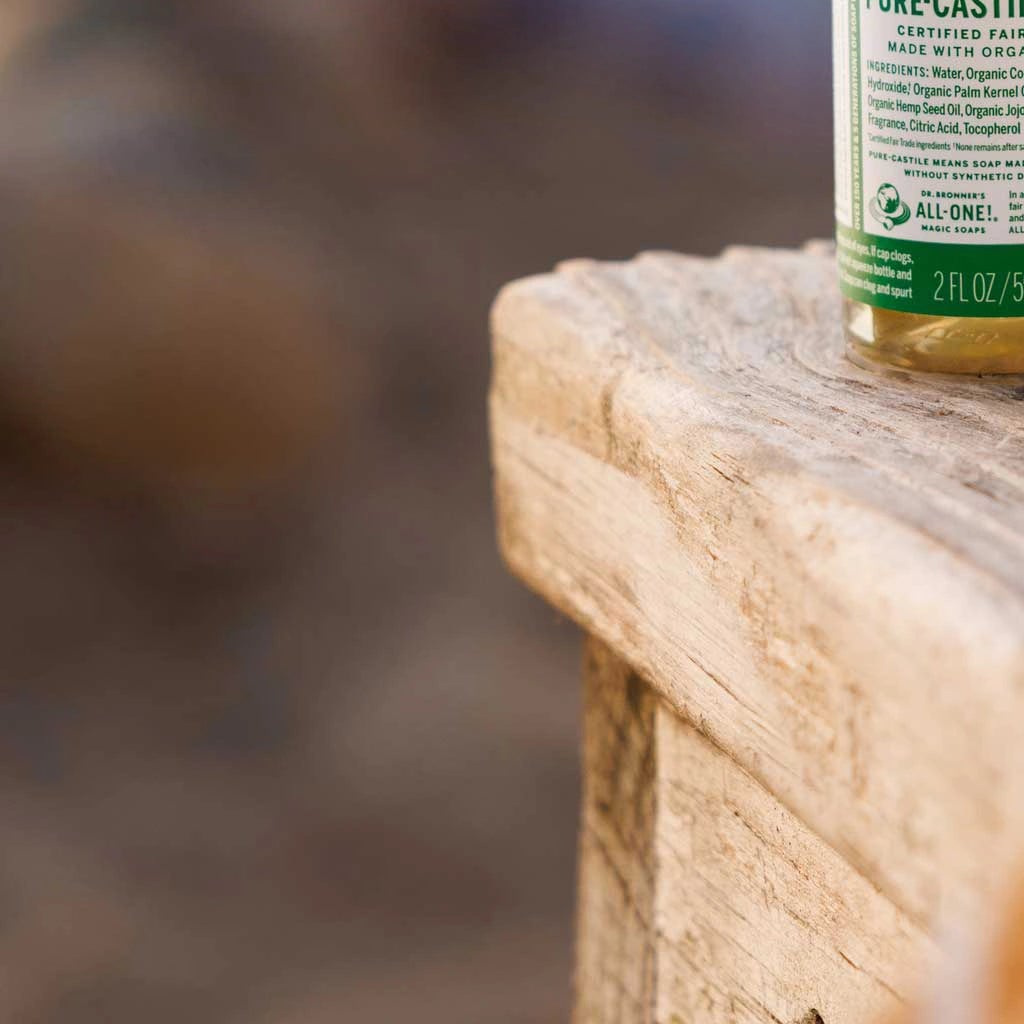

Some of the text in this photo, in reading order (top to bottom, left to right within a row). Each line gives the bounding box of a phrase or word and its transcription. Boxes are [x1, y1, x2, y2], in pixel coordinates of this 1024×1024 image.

[897, 25, 981, 39] CERTIFIED
[888, 41, 927, 55] MADE
[933, 45, 974, 57] WITH
[866, 60, 929, 78] INGREDIENTS:
[932, 66, 964, 80] Water,
[966, 67, 1007, 82] Organic
[914, 83, 952, 99] Organic
[954, 85, 980, 98] Palm
[984, 85, 1018, 98] Kernel
[868, 94, 895, 111] Organic
[896, 99, 920, 115] Hemp
[923, 102, 945, 115] Seed
[948, 103, 963, 117] Oil,
[965, 104, 1003, 119] Organic
[868, 112, 1021, 138] Fragrance, Citric Acid, Tocopherol
[900, 137, 915, 148] Trade
[974, 143, 1001, 152] remains
[1002, 142, 1018, 152] after
[868, 151, 929, 166] PURE-CASTILE
[933, 159, 969, 168] MEANS
[973, 160, 1001, 168] SOAP
[904, 169, 948, 180] WITHOUT
[952, 172, 1013, 181] SYNTHETIC
[936, 191, 986, 199] BRONNER'S
[1009, 190, 1017, 199] In
[1009, 202, 1022, 211] fair
[1009, 214, 1024, 223] and
[921, 225, 986, 234] MAGIC SOAPS
[877, 248, 889, 262] cap
[890, 250, 914, 265] clogs,
[873, 263, 895, 279] bottle
[896, 268, 912, 280] and
[877, 283, 890, 295] and
[891, 287, 912, 299] spurt
[934, 270, 944, 301] 2
[950, 272, 969, 302] FL
